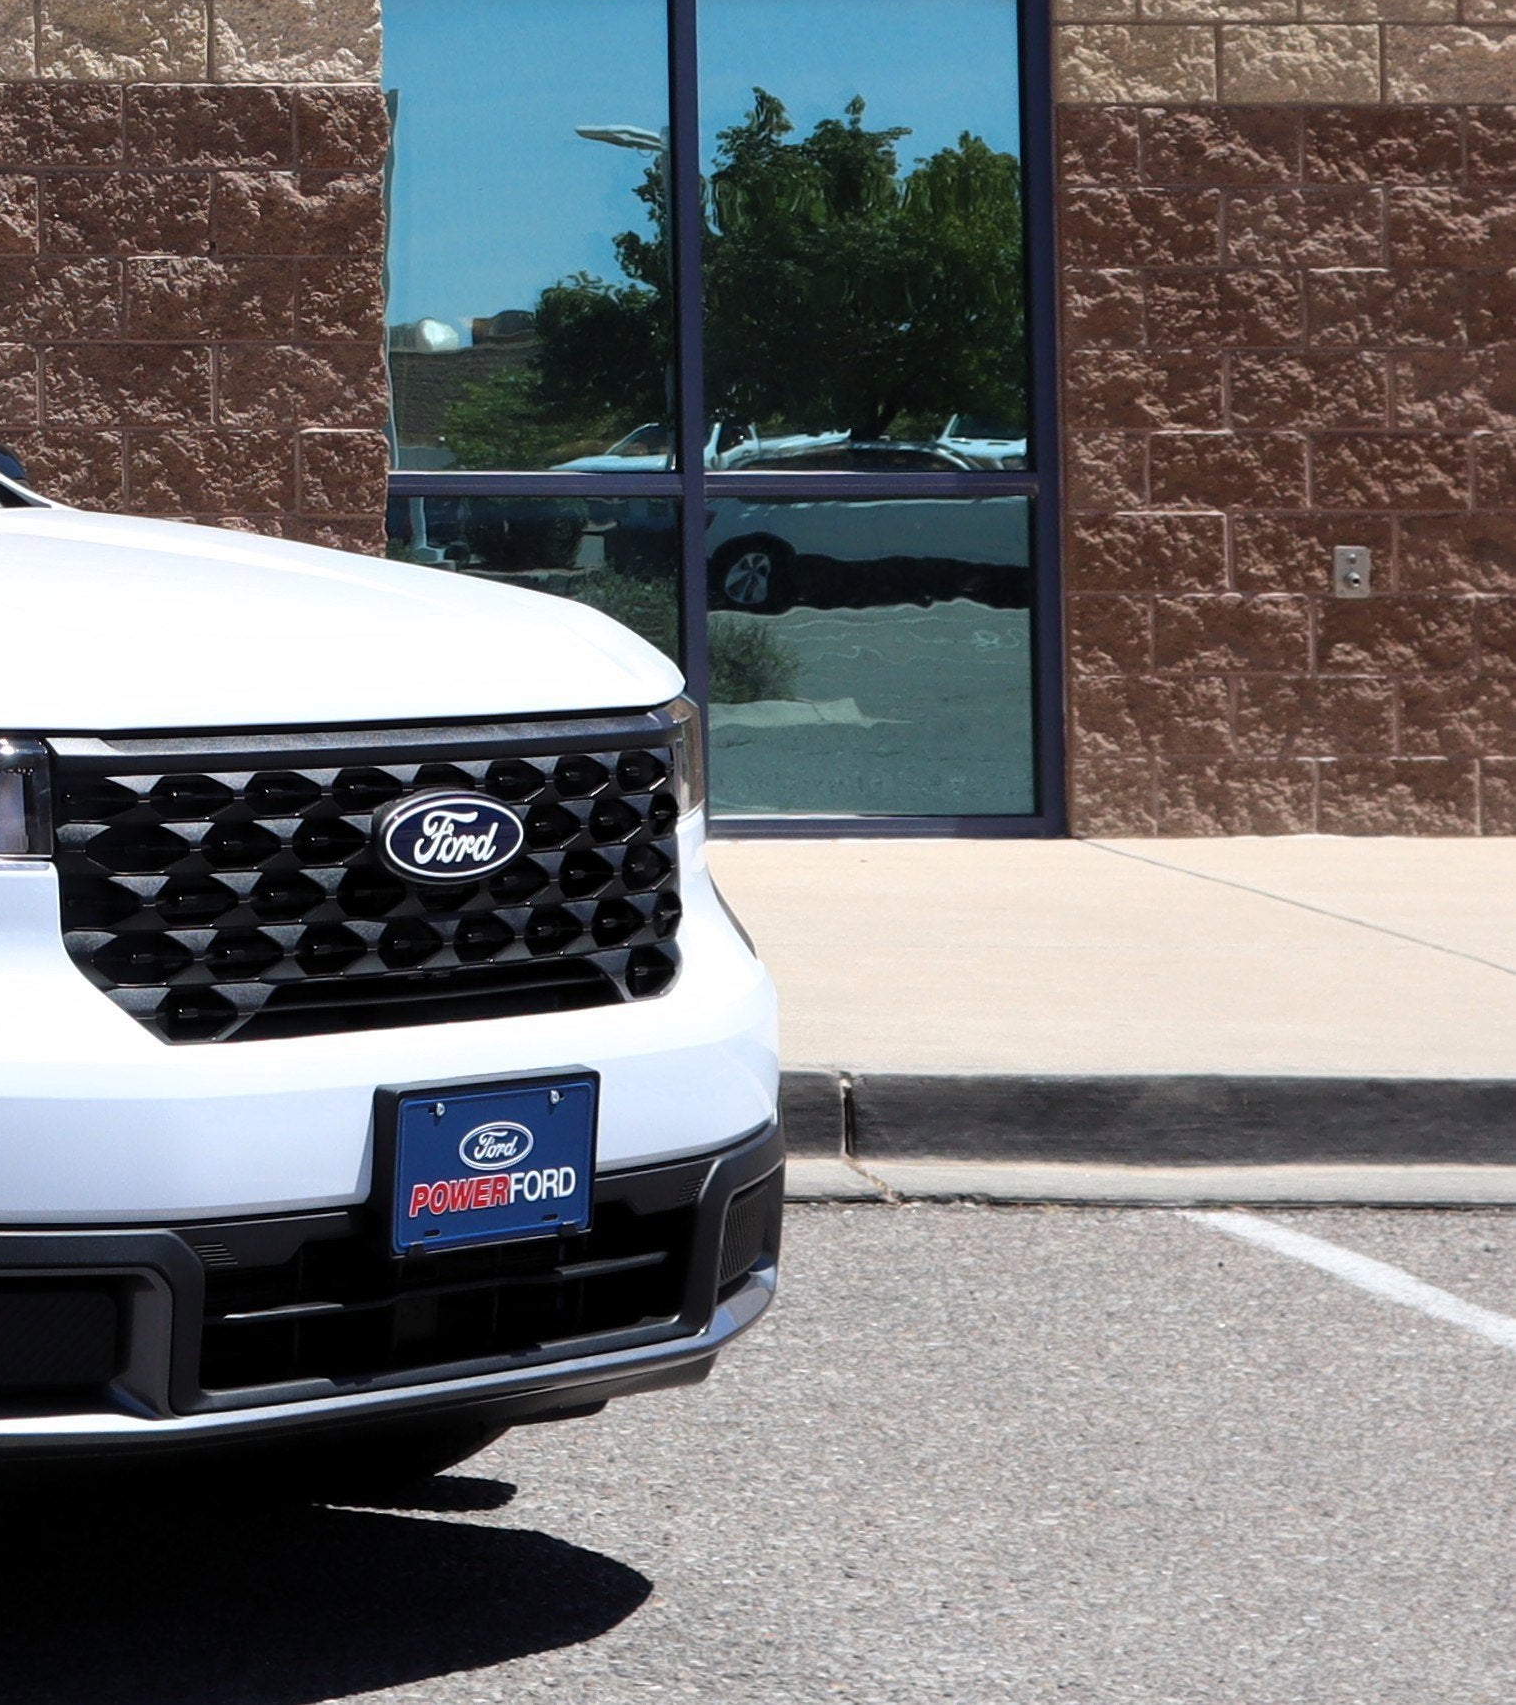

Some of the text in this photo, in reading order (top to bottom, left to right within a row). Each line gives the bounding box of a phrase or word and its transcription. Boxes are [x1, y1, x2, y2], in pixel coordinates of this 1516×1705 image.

[414, 809, 500, 865] Ford
[474, 1130, 518, 1160] Ford
[408, 1165, 576, 1218] POWERFORD
